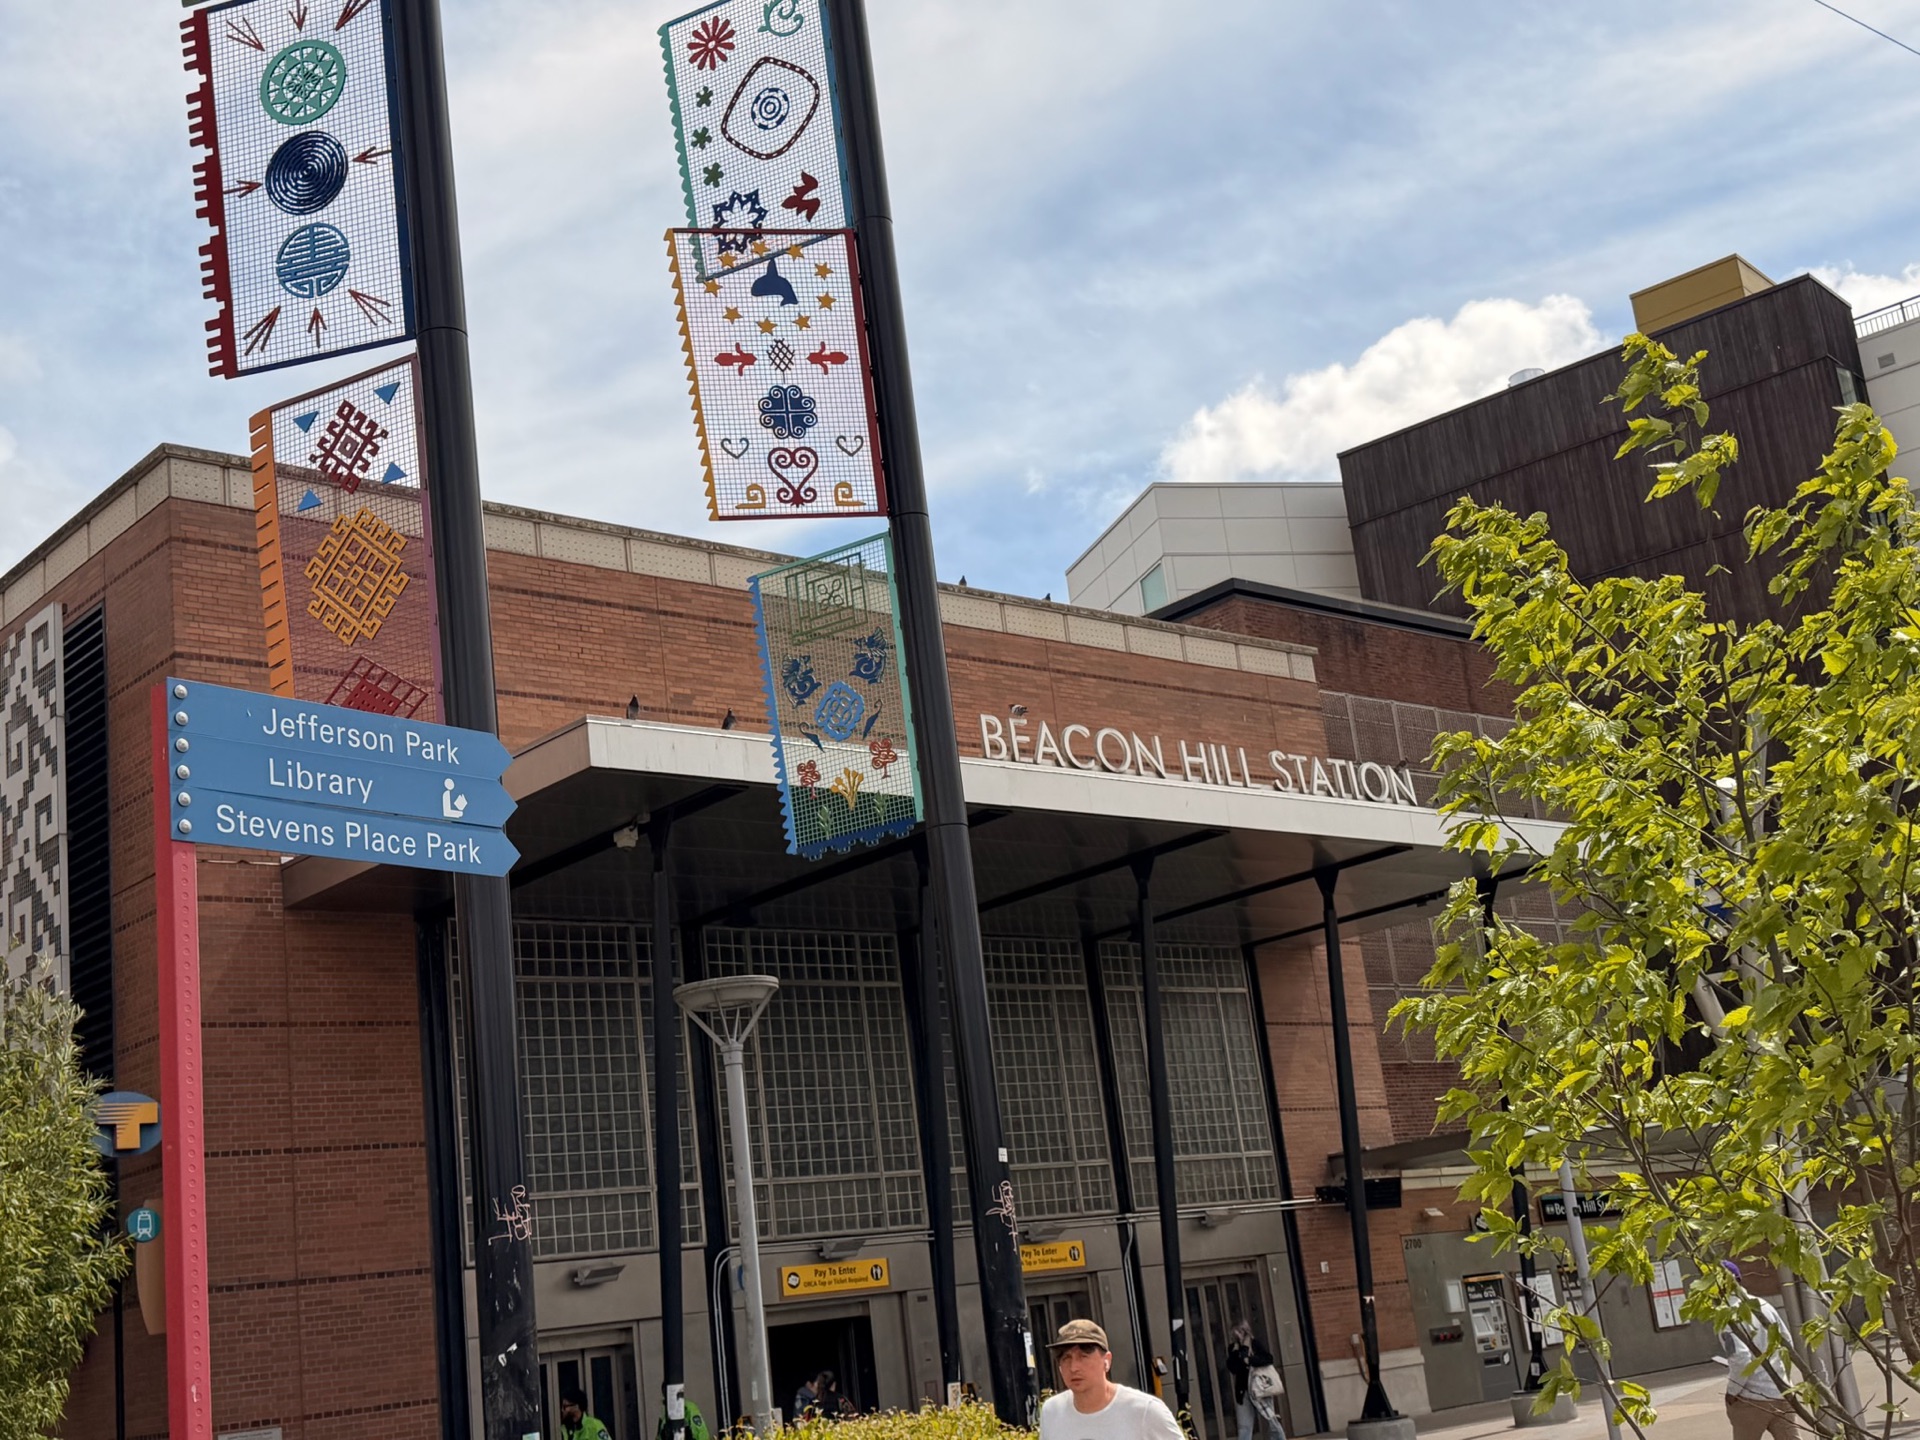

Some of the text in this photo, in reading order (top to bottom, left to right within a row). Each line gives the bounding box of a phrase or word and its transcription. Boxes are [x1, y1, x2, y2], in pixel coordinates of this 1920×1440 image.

[263, 708, 460, 765] Jefferson Park
[979, 713, 1418, 806] BEACON HILL STATION
[269, 757, 373, 804] Library
[216, 804, 482, 865] Stevens Place Park
[1021, 1247, 1058, 1259] Pay To Enter
[1404, 1238, 1422, 1250] 2700
[814, 1266, 857, 1279] Pay To Enter
